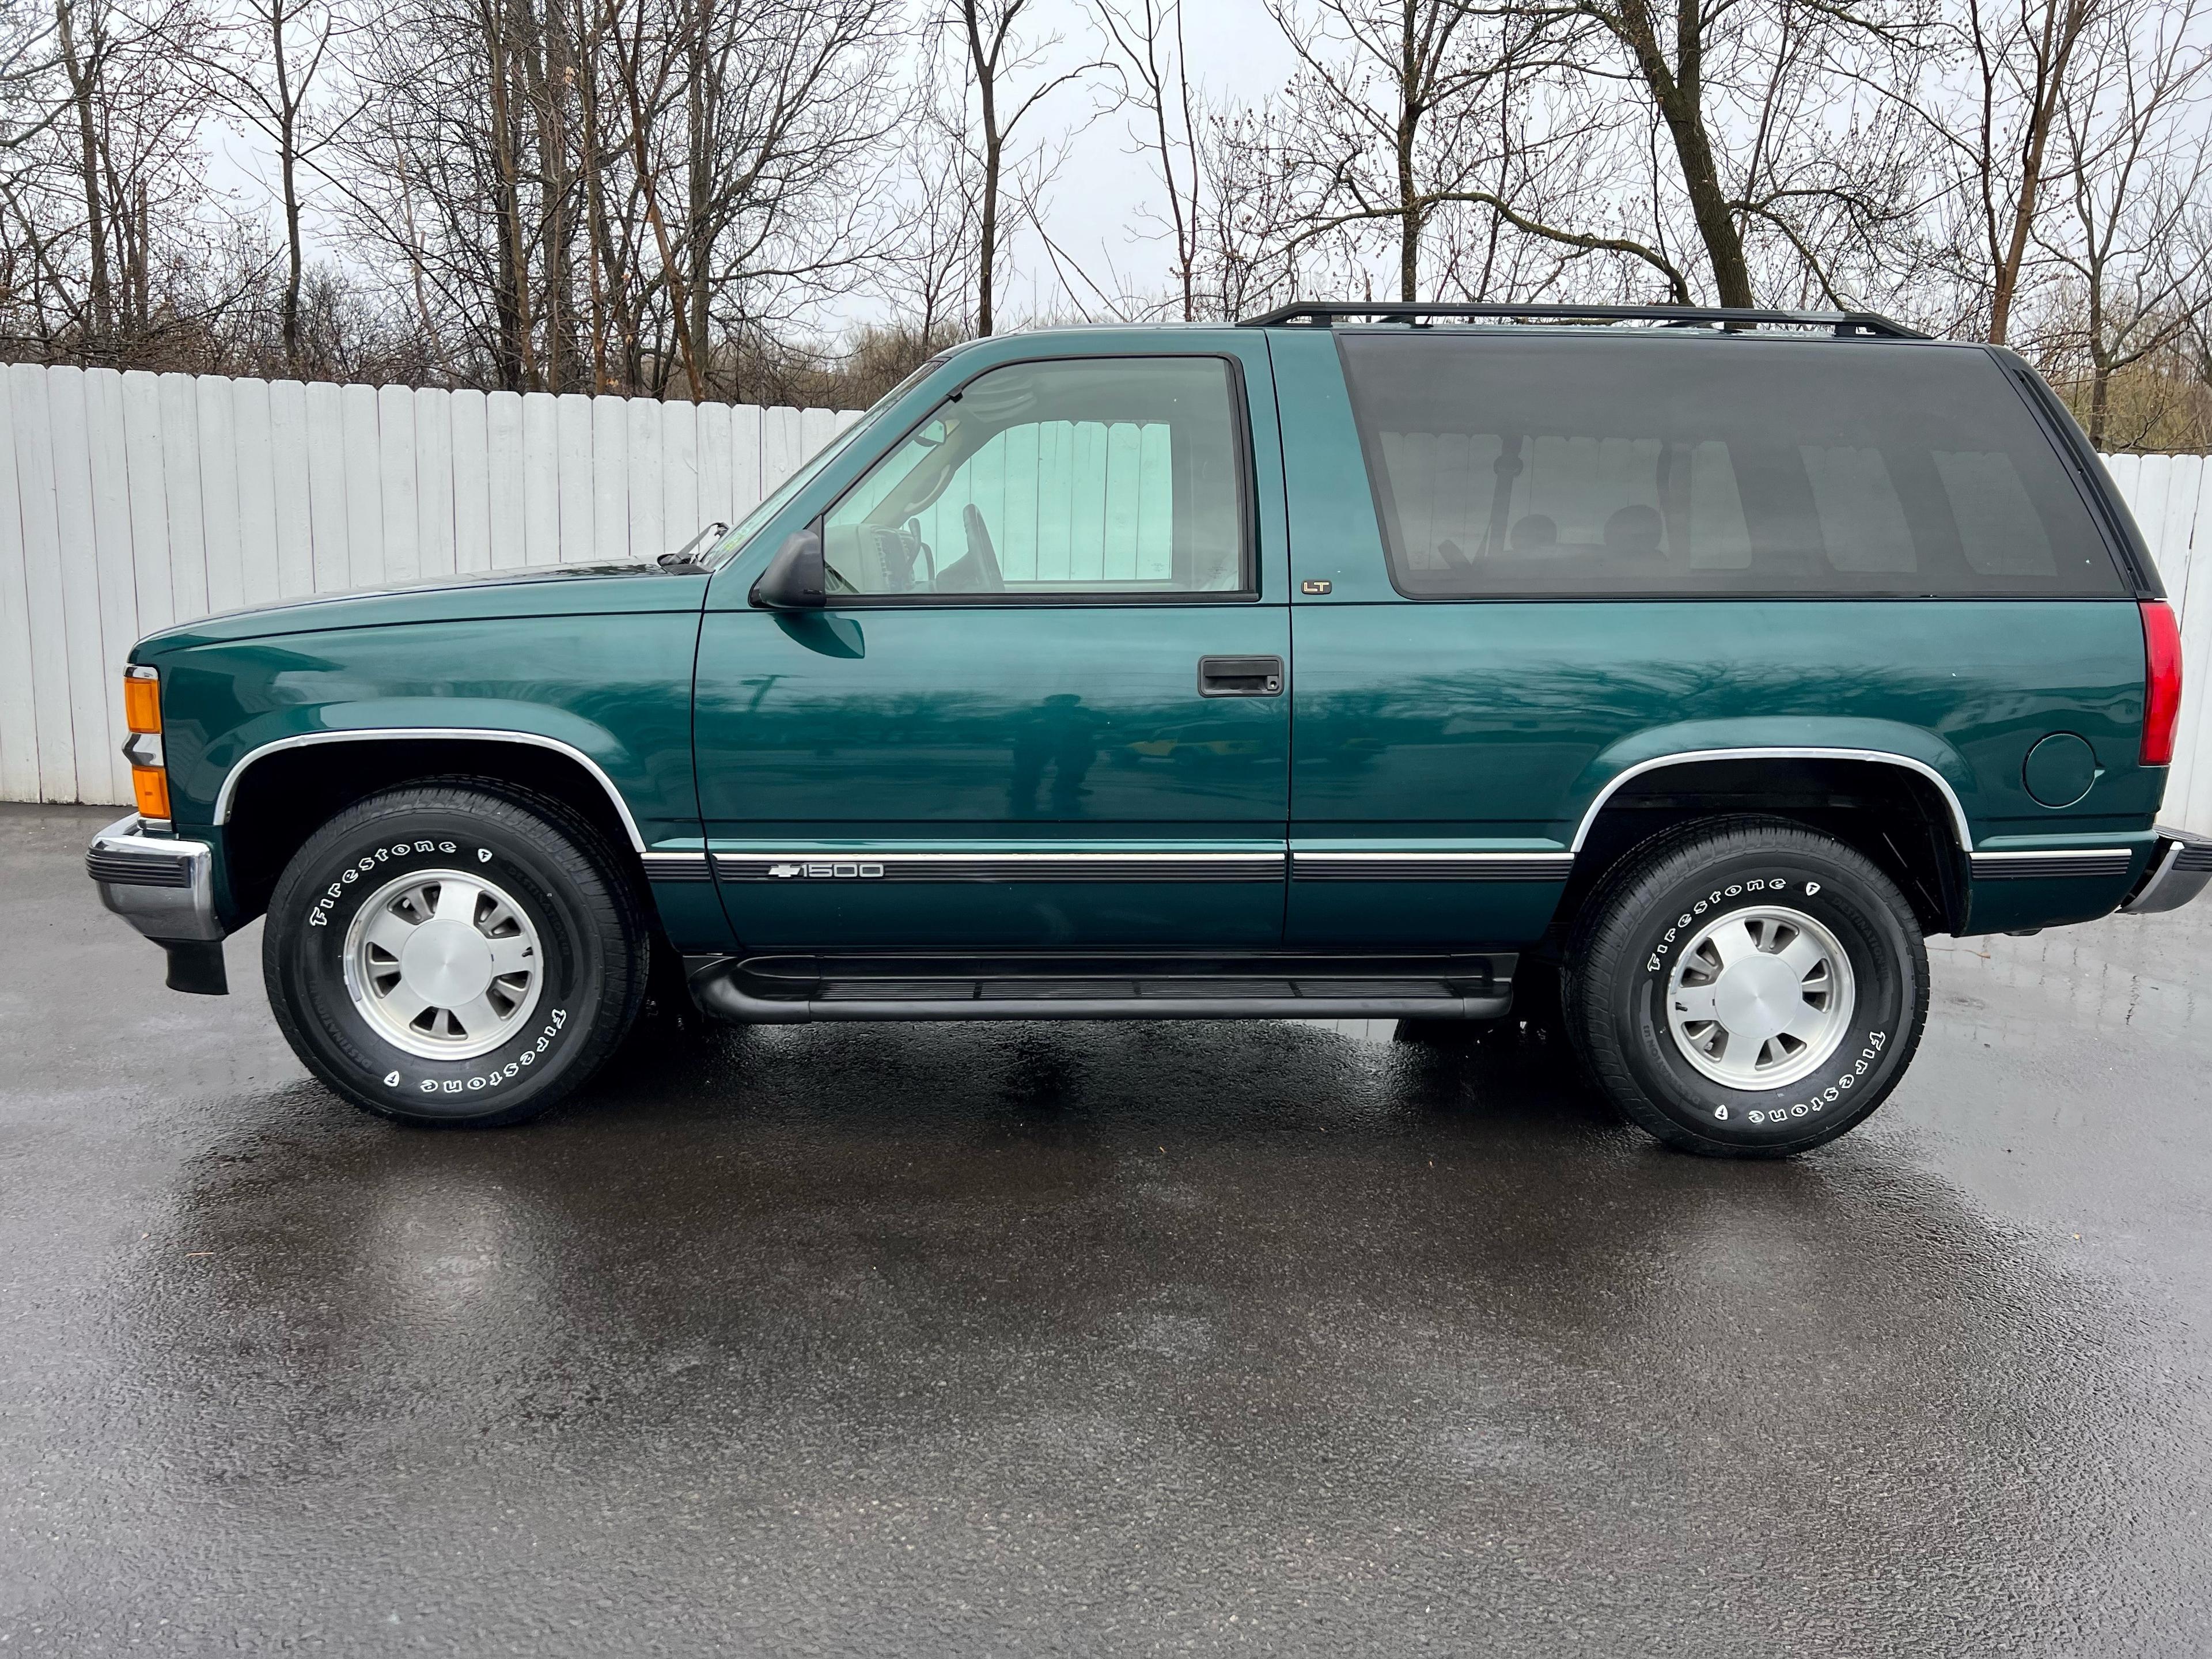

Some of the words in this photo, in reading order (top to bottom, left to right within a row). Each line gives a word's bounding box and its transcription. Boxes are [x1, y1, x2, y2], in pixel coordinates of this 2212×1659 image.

[1304, 582, 1330, 592] LT
[309, 840, 457, 926] Firestone
[801, 862, 884, 877] 1500
[1647, 878, 1786, 972] Firestone
[420, 1009, 567, 1093] Firestone
[1748, 1031, 1886, 1123] Firestone
